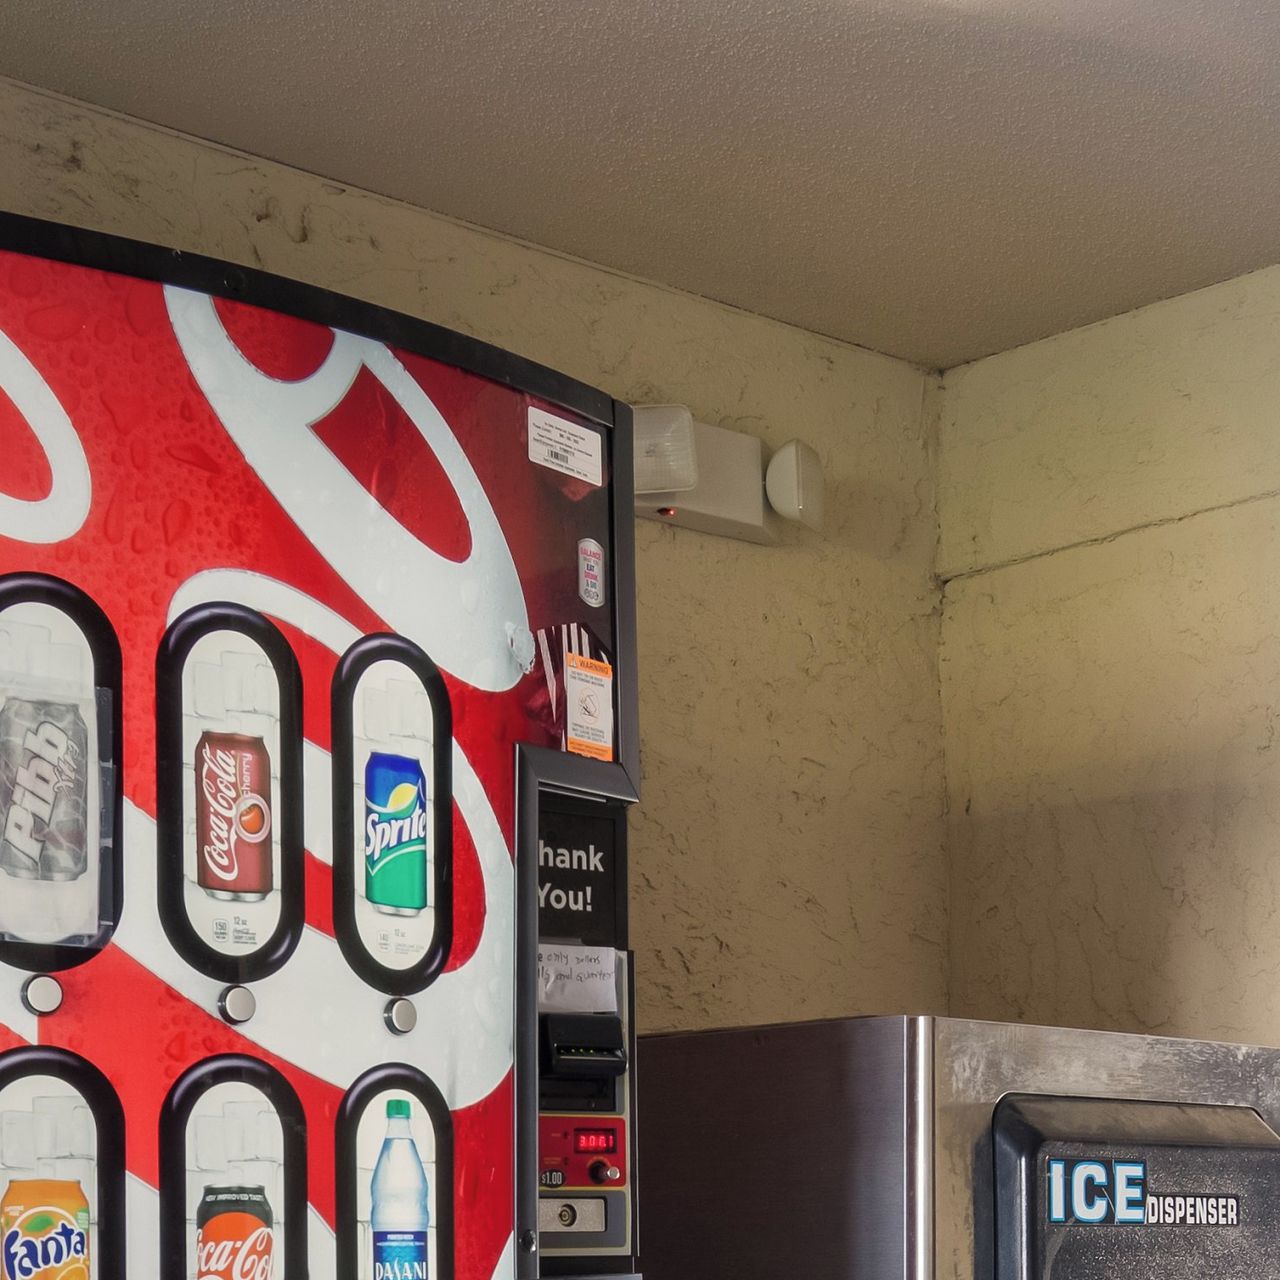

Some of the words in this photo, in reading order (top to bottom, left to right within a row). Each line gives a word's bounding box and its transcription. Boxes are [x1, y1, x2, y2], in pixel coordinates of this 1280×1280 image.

[580, 660, 609, 675] WARNING
[3, 720, 72, 866] Pibb
[203, 742, 239, 881] Coca-Cola
[366, 800, 426, 861] Sprite
[539, 840, 604, 872] hank
[538, 883, 592, 912] You!
[547, 952, 569, 965] only
[542, 1172, 562, 1184] $1.00
[1049, 1160, 1146, 1223] ICE
[1147, 1195, 1237, 1225] DISPENSER
